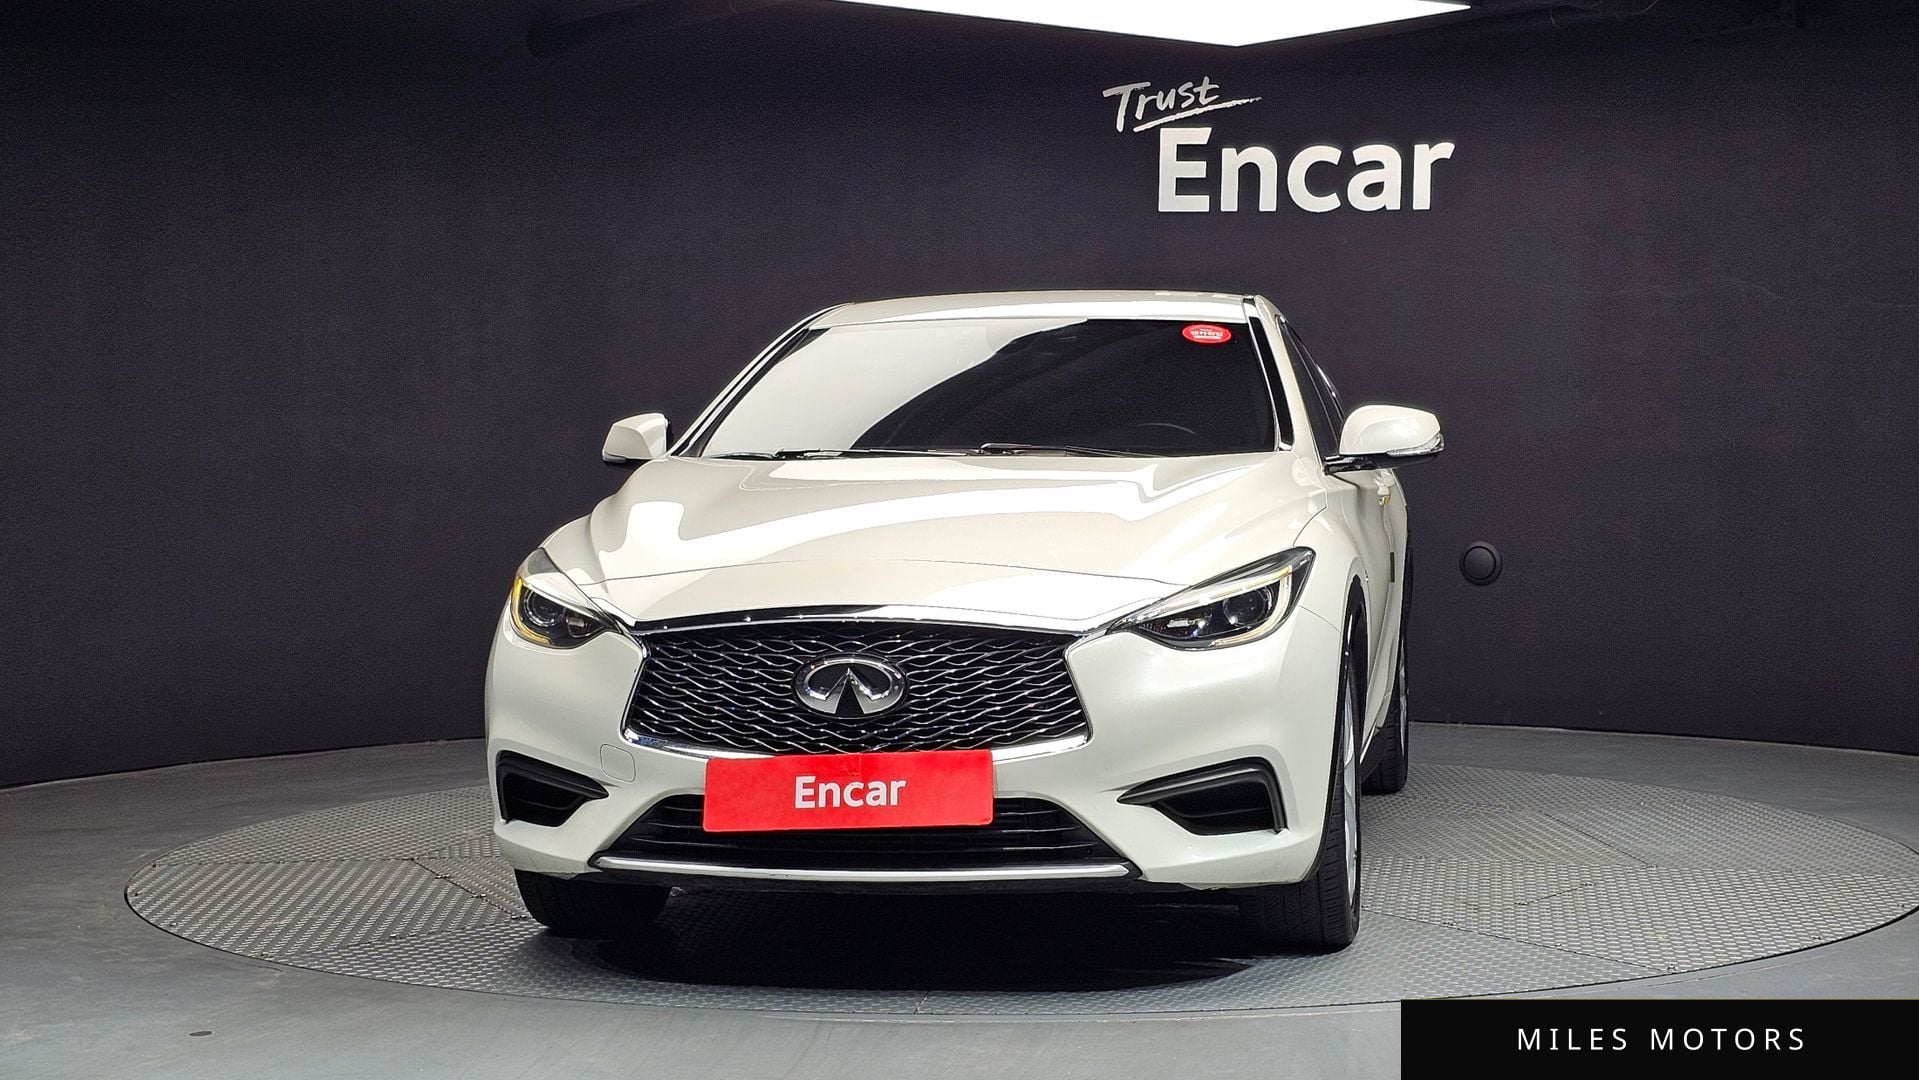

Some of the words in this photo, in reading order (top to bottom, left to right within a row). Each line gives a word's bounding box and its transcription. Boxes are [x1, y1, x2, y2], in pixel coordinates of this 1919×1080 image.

[1102, 75, 1221, 134] Trust
[1157, 126, 1456, 213] Encar
[794, 775, 907, 809] Encar
